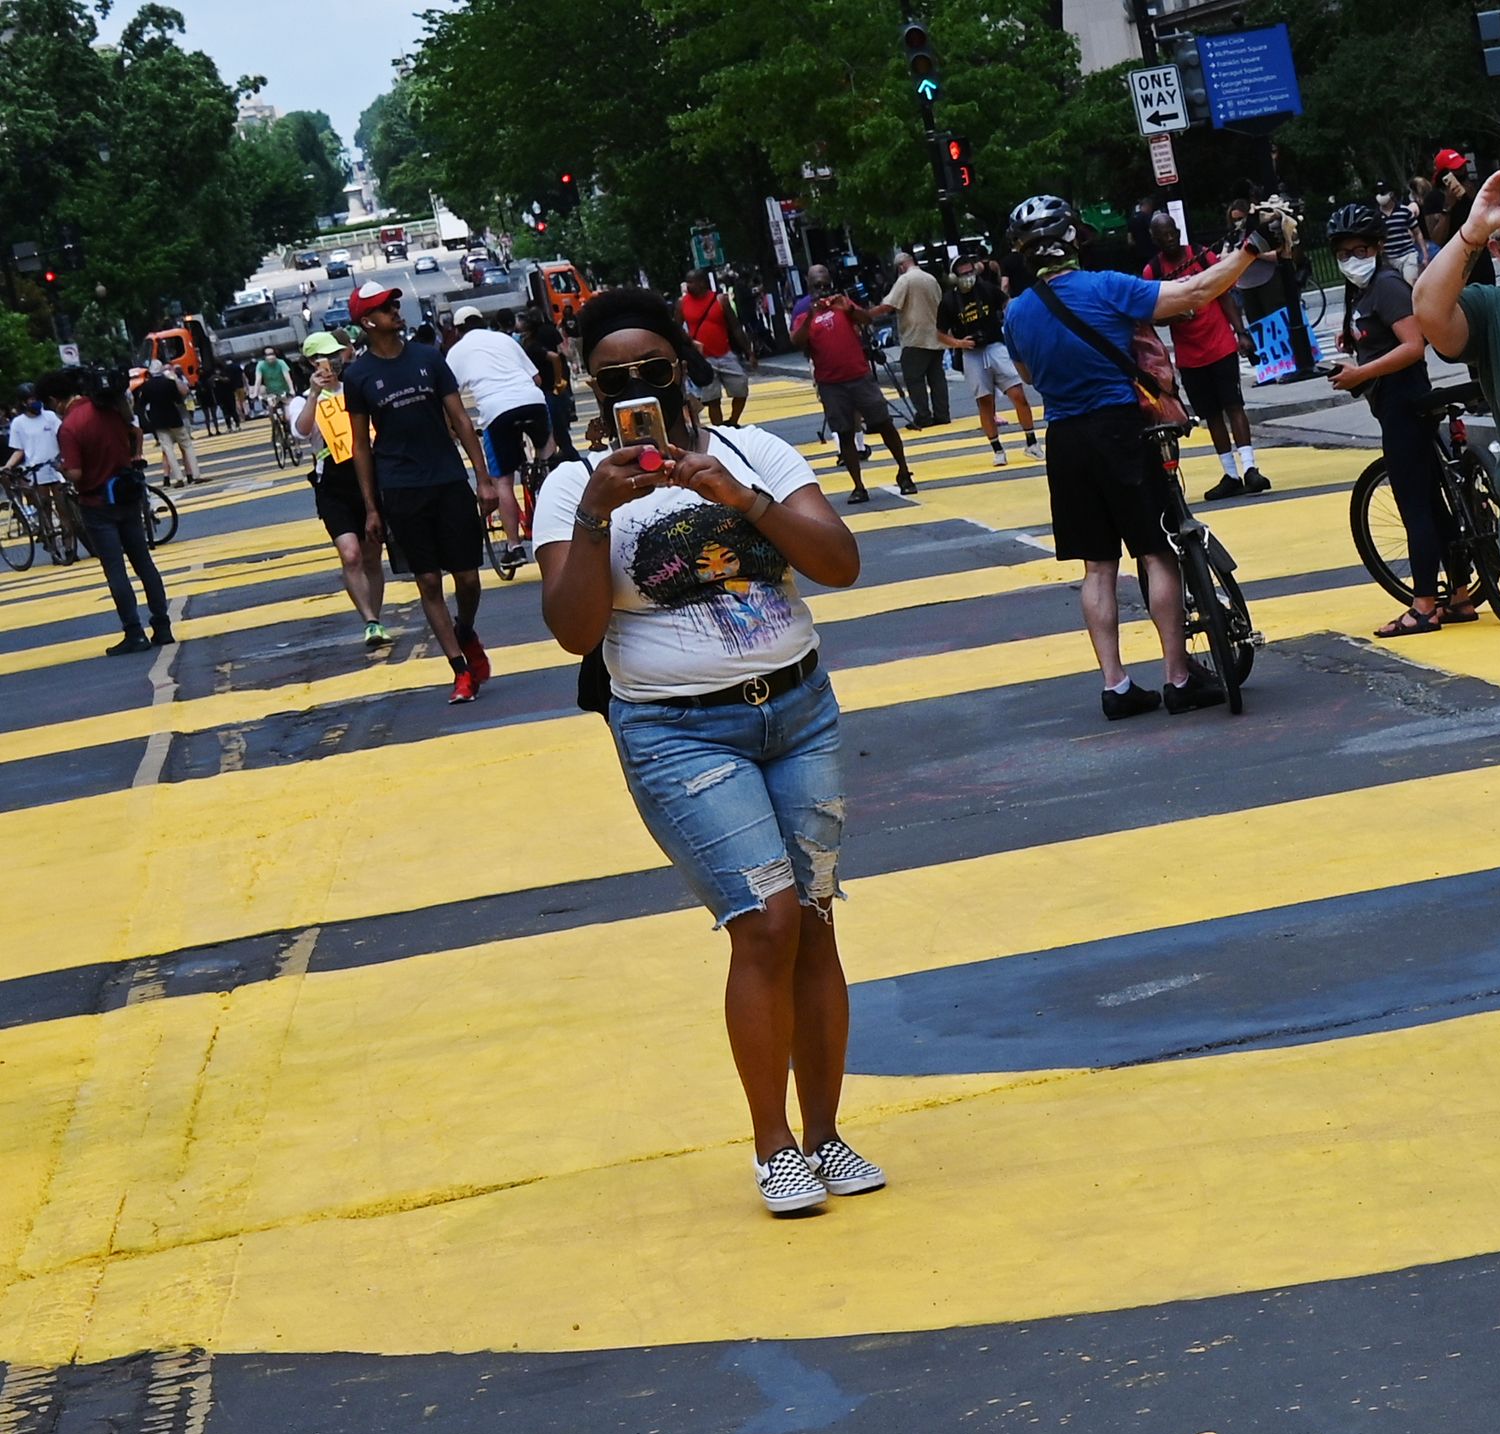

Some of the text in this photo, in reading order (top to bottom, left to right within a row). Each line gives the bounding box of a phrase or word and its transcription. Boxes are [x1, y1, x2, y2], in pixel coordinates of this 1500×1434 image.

[1138, 71, 1174, 91] ONE
[1140, 89, 1177, 108] WAY
[960, 167, 970, 187] 3
